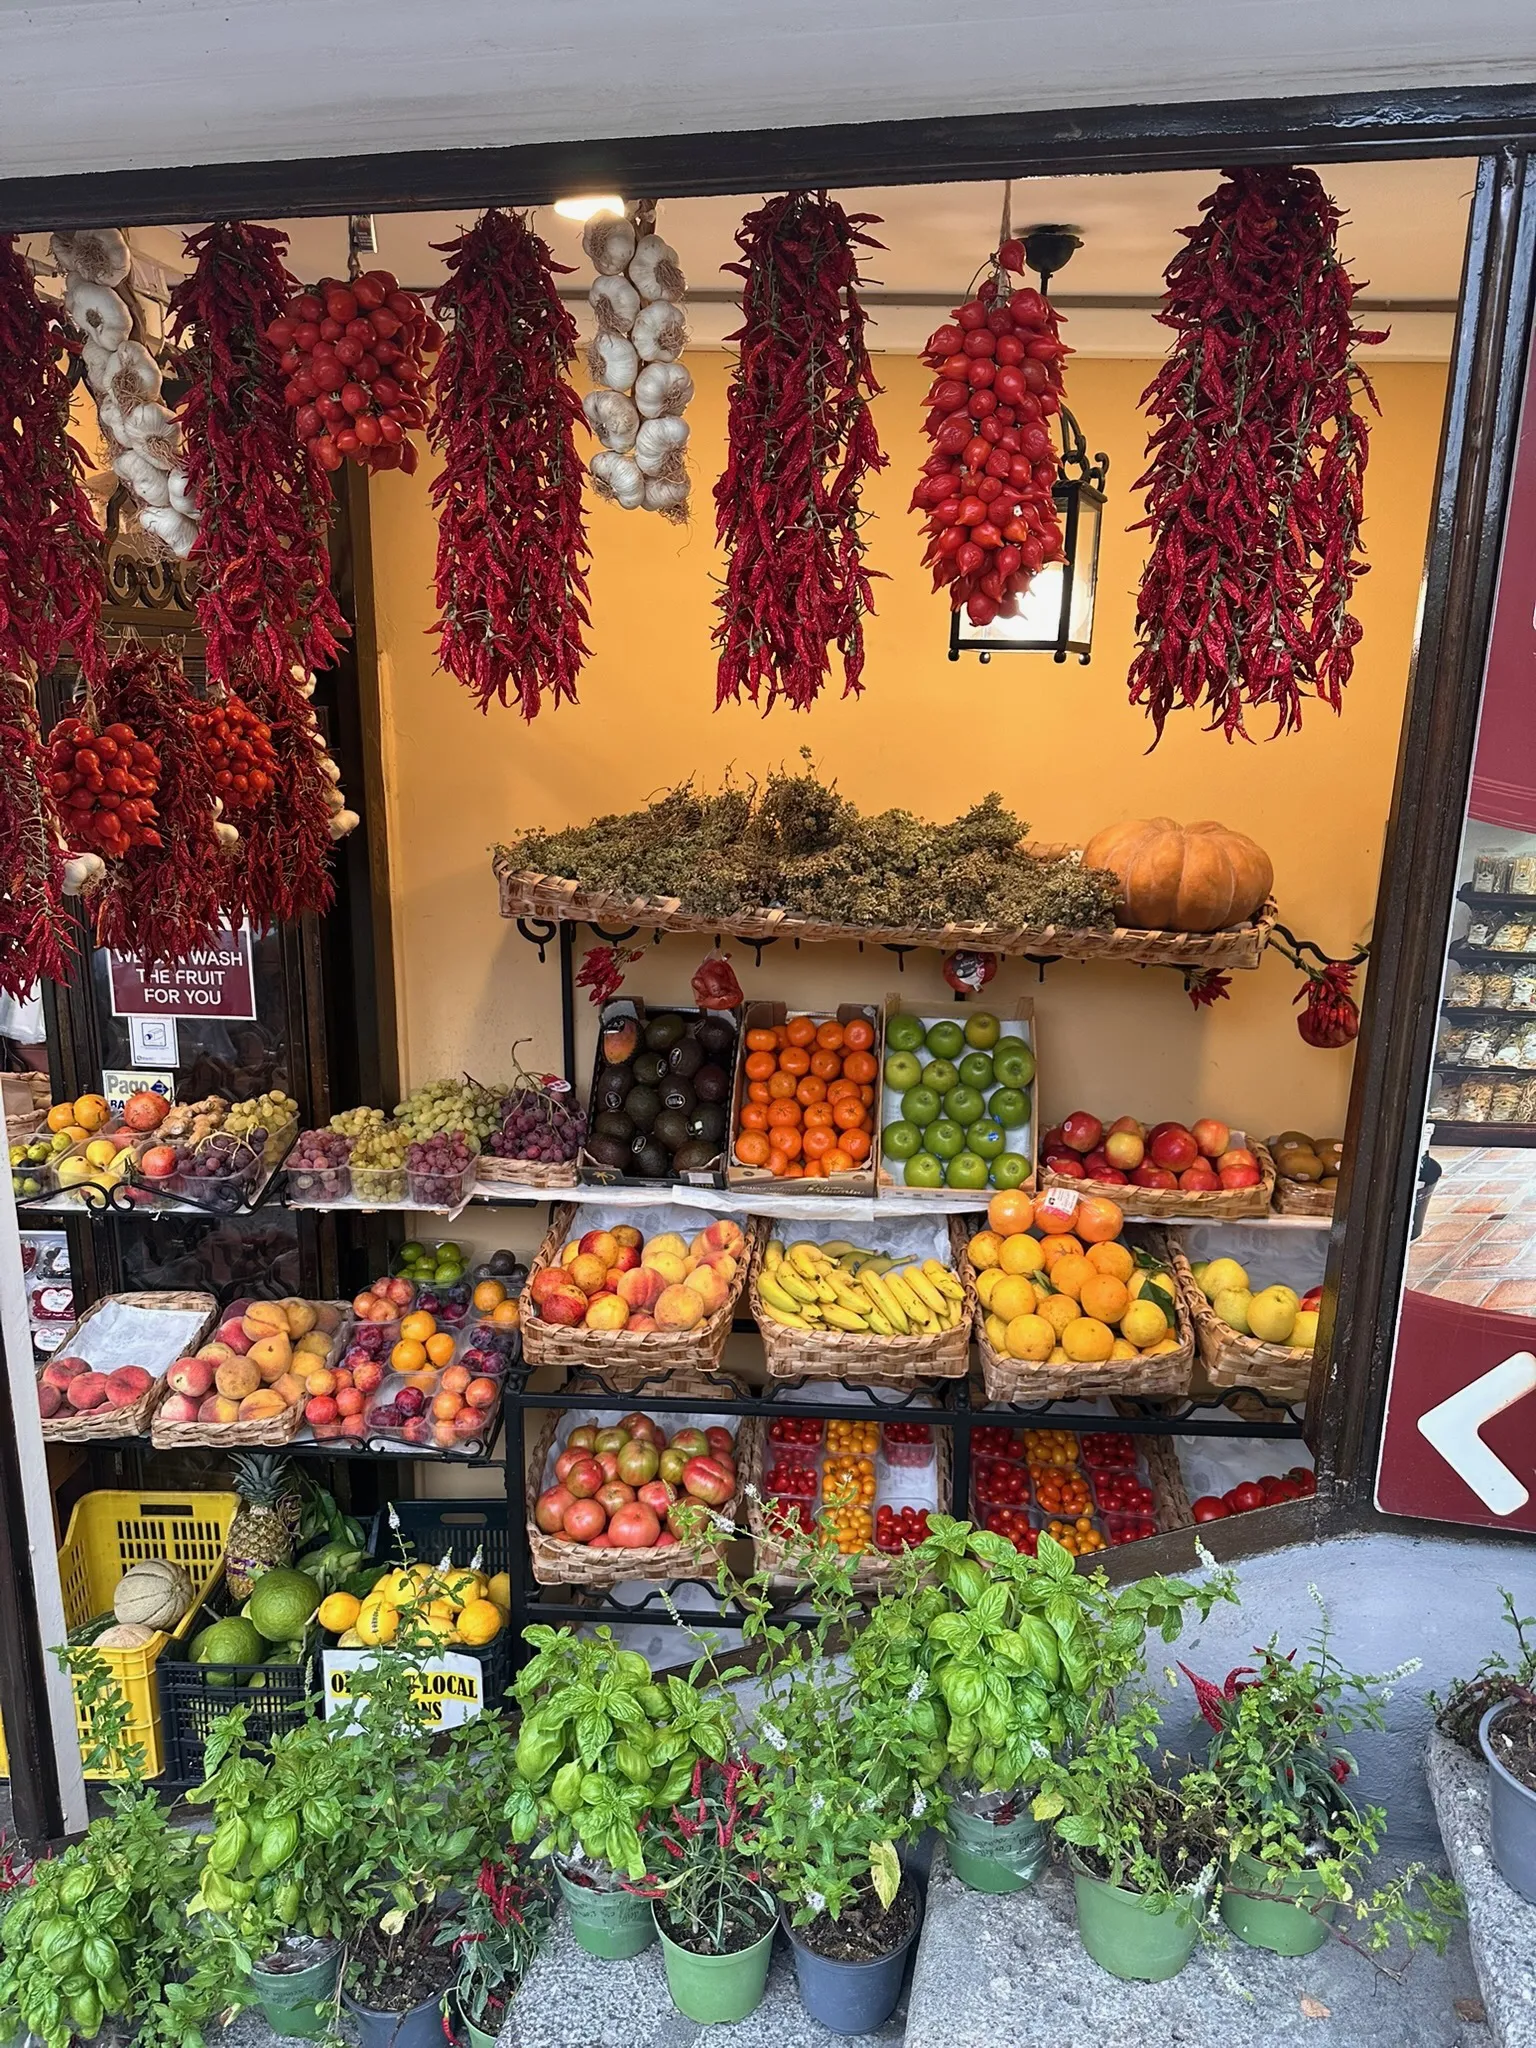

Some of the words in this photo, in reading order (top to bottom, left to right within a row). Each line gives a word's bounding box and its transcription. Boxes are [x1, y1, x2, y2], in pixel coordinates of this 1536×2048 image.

[190, 950, 243, 967] WASH
[135, 969, 170, 984] THE
[175, 970, 225, 985] FRUIT
[144, 989, 181, 1004] FOR
[184, 989, 221, 1005] YOU
